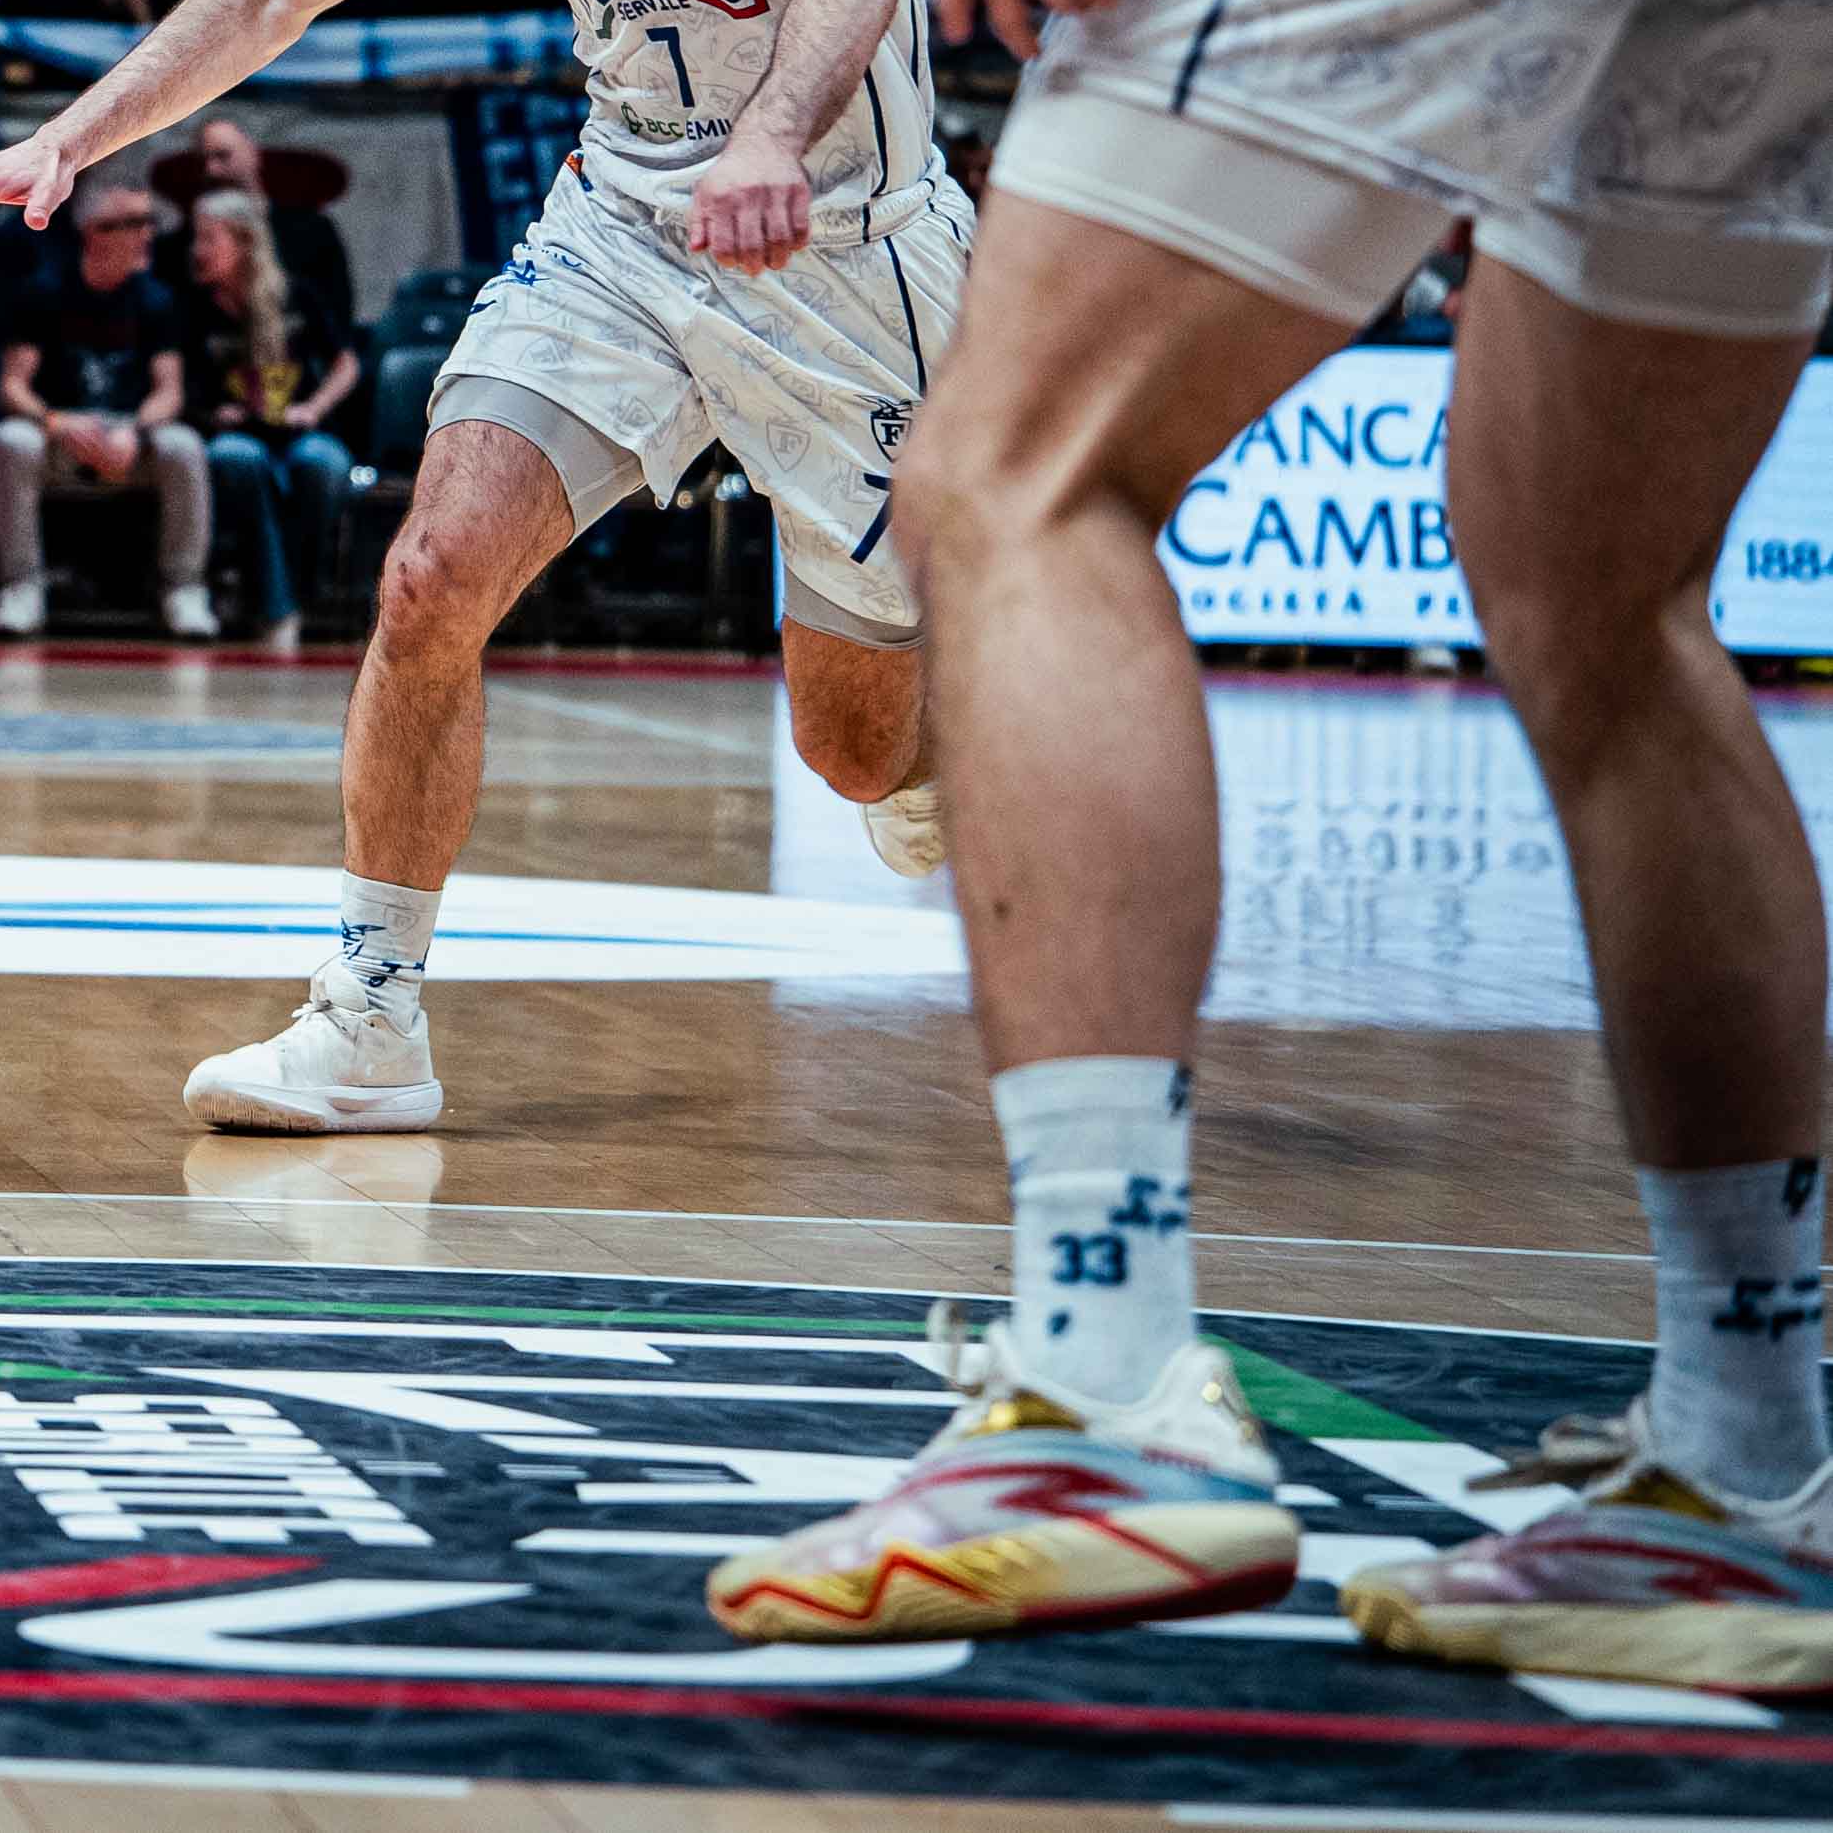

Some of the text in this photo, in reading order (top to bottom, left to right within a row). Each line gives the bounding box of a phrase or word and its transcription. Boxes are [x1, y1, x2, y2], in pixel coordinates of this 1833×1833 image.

[645, 26, 695, 109] 7
[644, 116, 685, 139] BCC
[1234, 403, 1447, 468] ANCA
[1165, 480, 1455, 570] CAMB
[1050, 1231, 1129, 1286] 33
